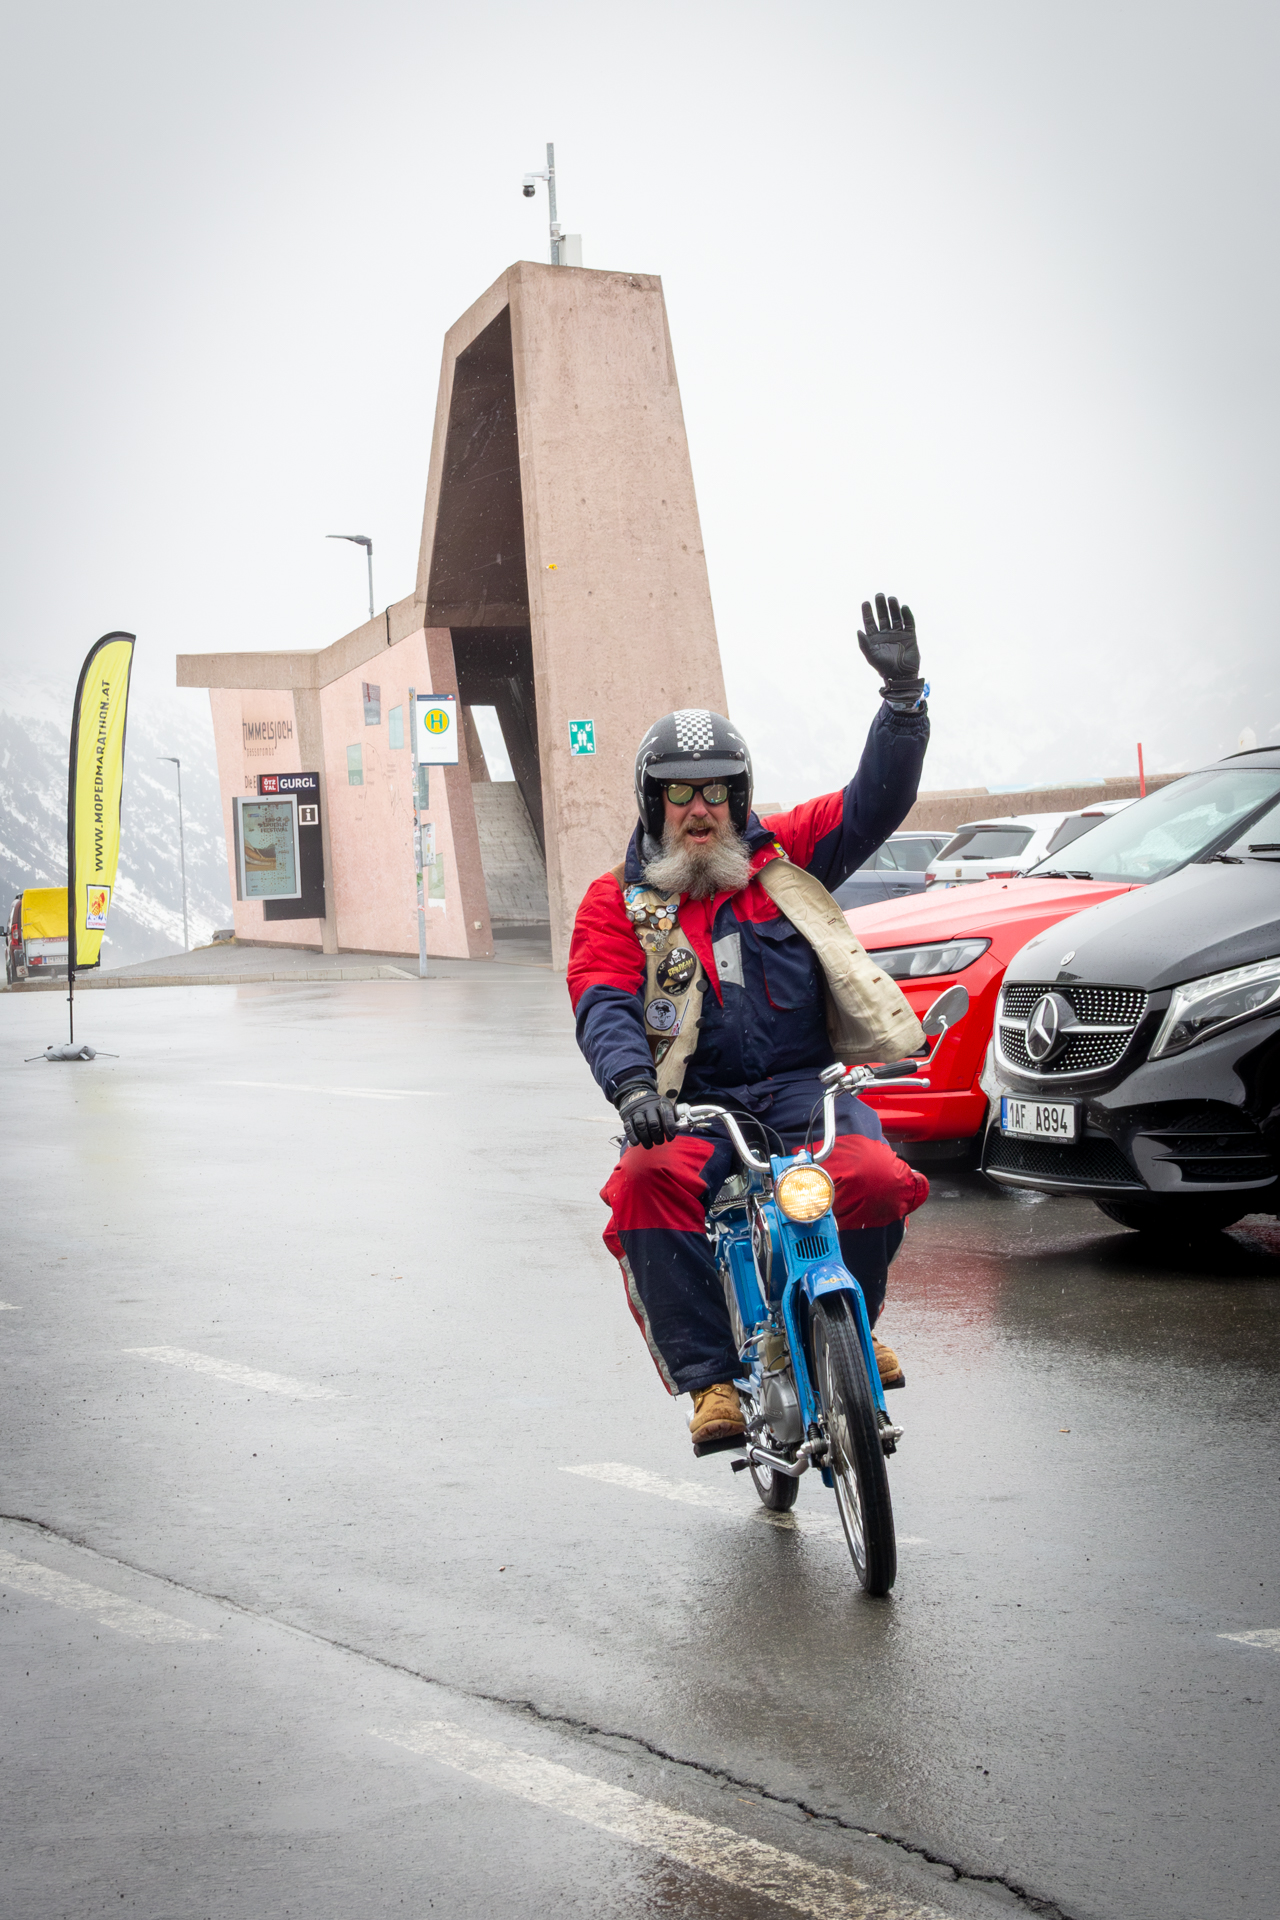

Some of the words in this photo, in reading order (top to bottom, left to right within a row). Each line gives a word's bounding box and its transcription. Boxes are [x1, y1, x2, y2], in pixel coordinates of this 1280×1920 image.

[430, 713, 443, 730] H
[94, 679, 111, 872] WWW.MOPEDMARATHON.AT
[280, 777, 316, 789] GURGL
[1010, 1103, 1026, 1129] 1AF
[1036, 1106, 1068, 1134] A894
